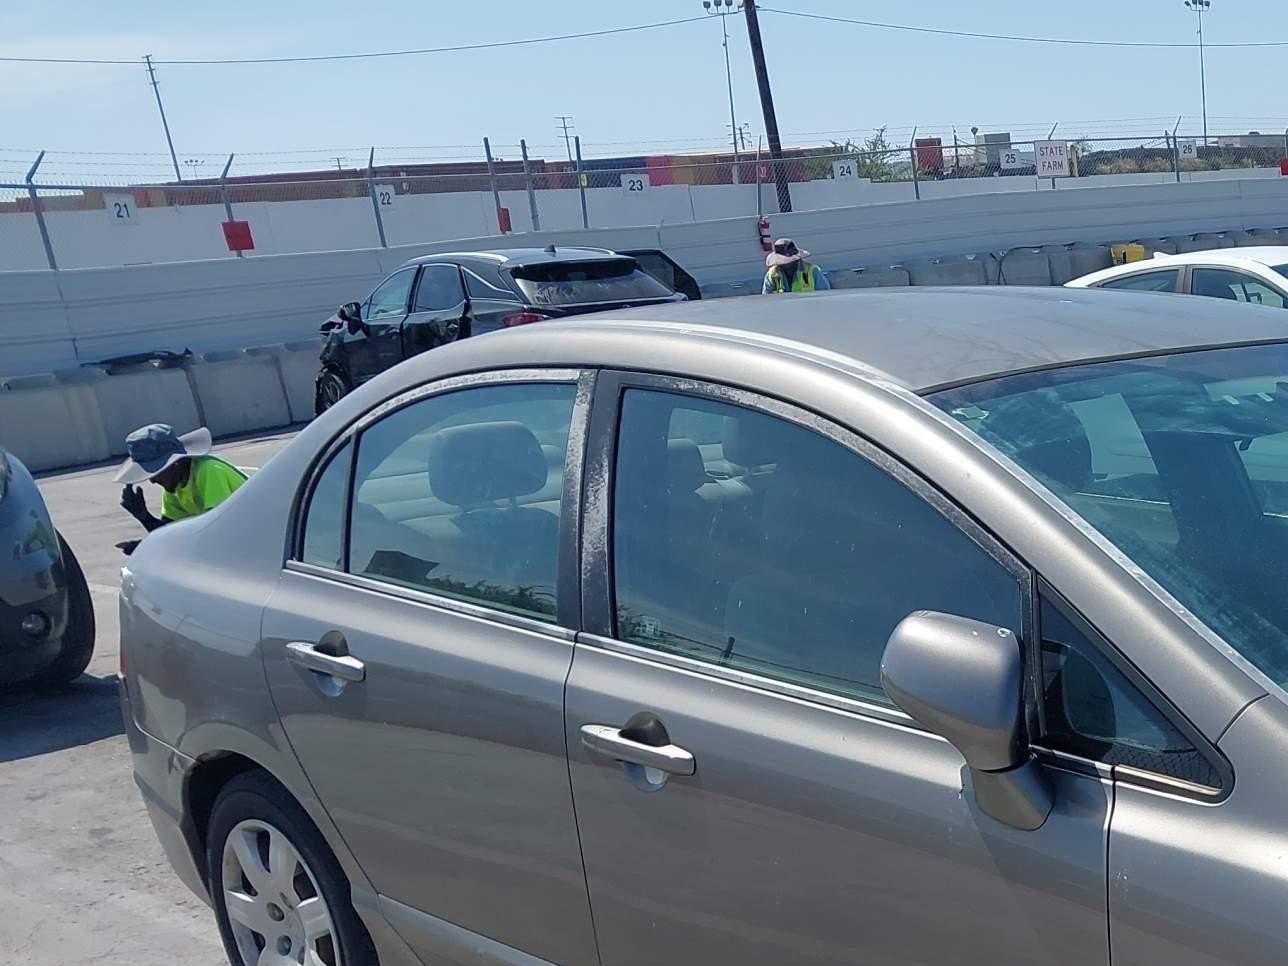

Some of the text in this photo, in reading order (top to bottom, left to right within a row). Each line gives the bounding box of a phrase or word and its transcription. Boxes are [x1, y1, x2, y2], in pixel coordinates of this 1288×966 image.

[1040, 145, 1064, 156] STATE
[1183, 144, 1192, 153] 26
[1005, 154, 1016, 163] 25
[840, 165, 851, 176] 24
[1041, 160, 1064, 171] FARM
[629, 179, 643, 191] 23
[380, 191, 392, 205] 22
[114, 202, 130, 218] 21
